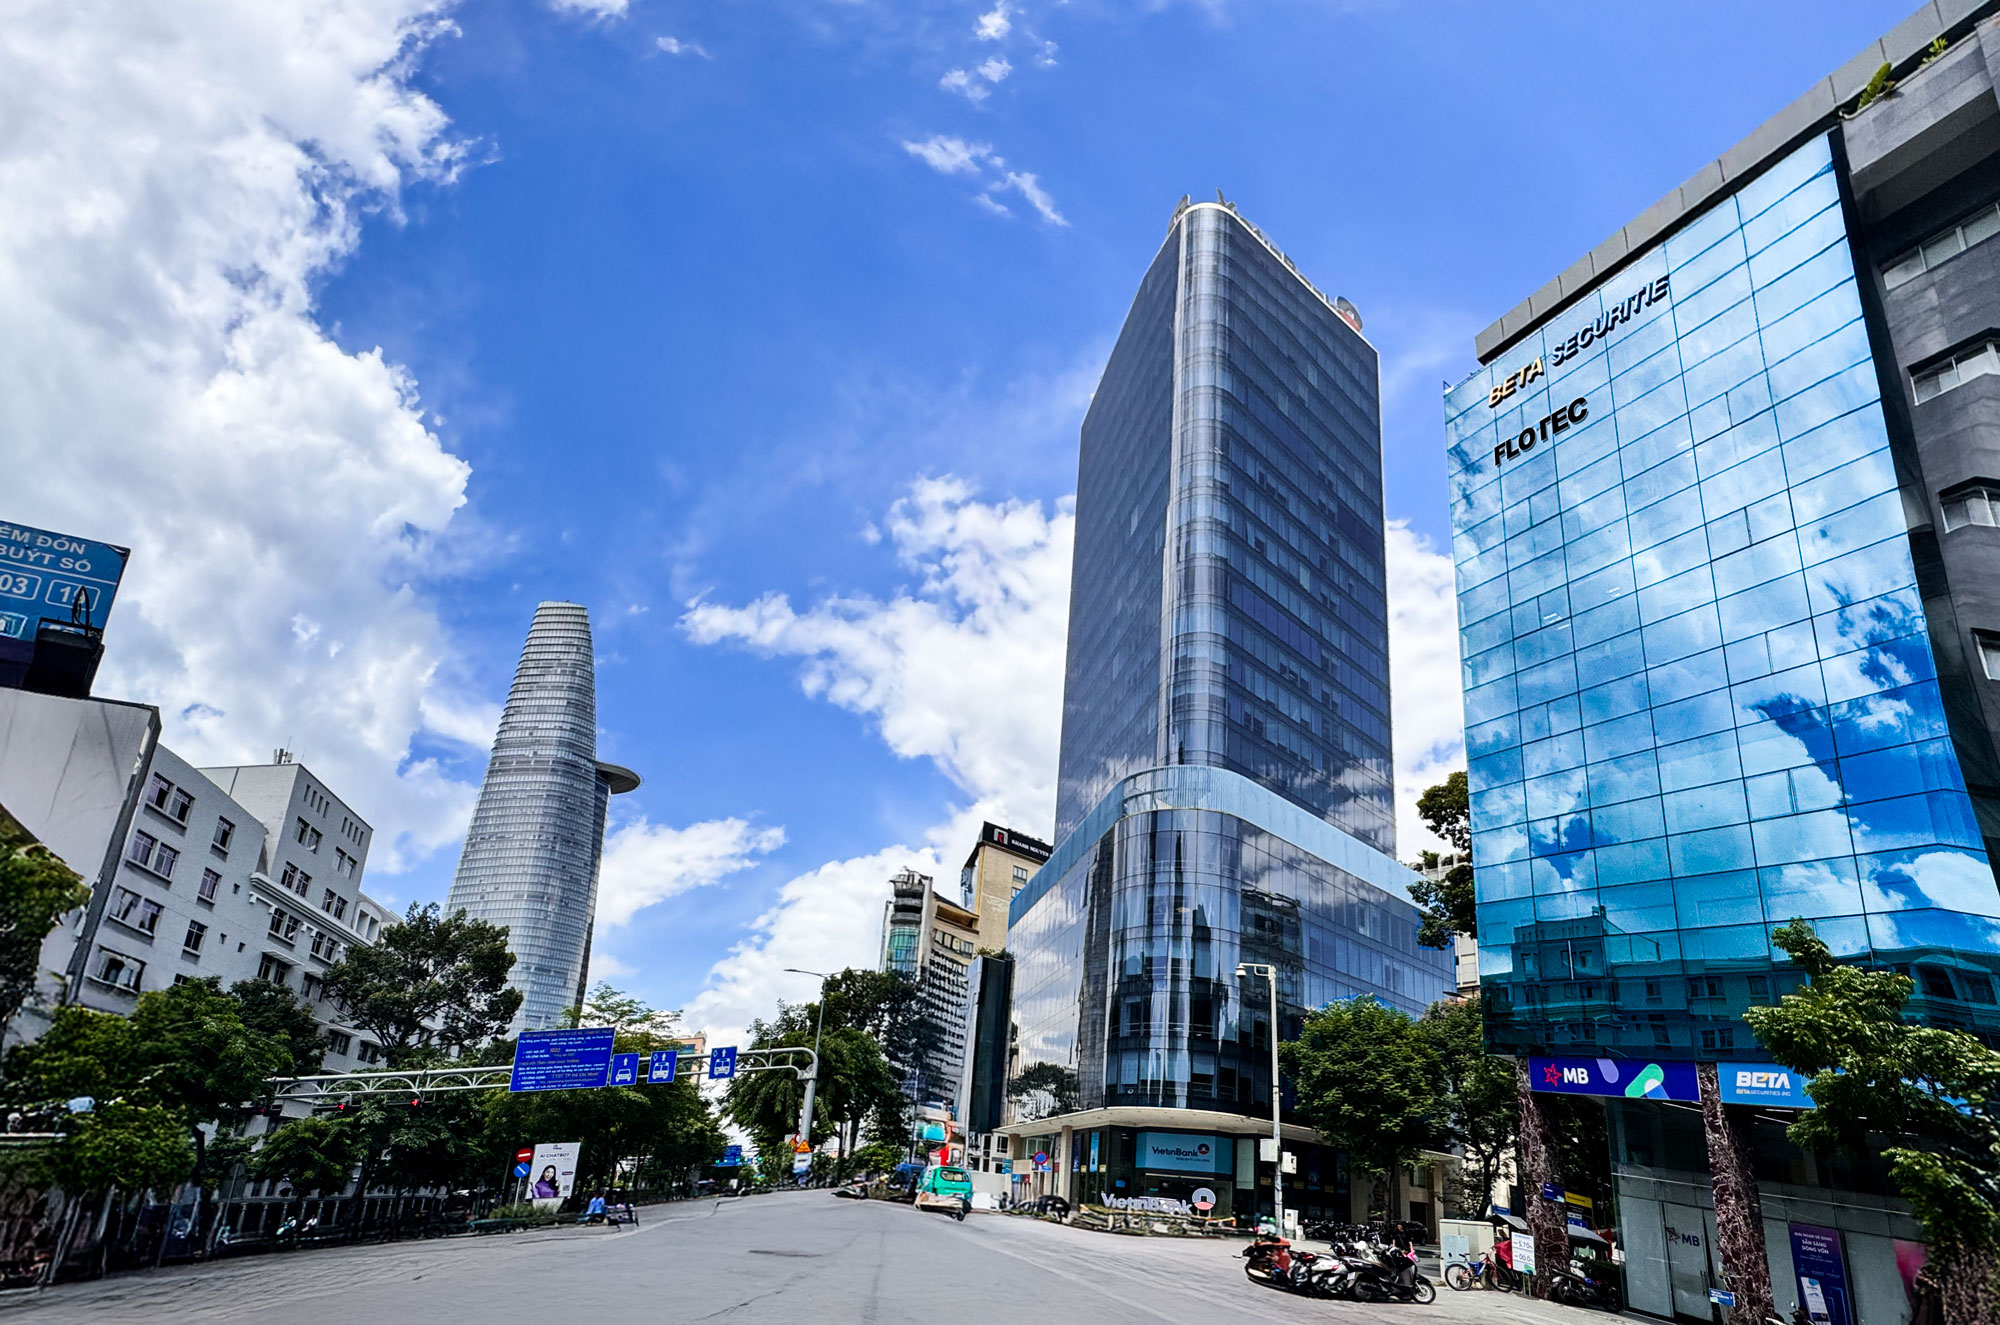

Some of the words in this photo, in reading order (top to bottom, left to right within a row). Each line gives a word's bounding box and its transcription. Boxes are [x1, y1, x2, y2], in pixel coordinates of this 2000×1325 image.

[1488, 356, 1544, 408] BETA
[1493, 397, 1588, 467] FLOTEC
[36, 534, 85, 555] ĐÓN
[1563, 1067, 1589, 1084] MB
[1736, 1071, 1790, 1089] BETA
[1152, 1146, 1198, 1157] VietinBank
[1681, 1233, 1700, 1247] MB
